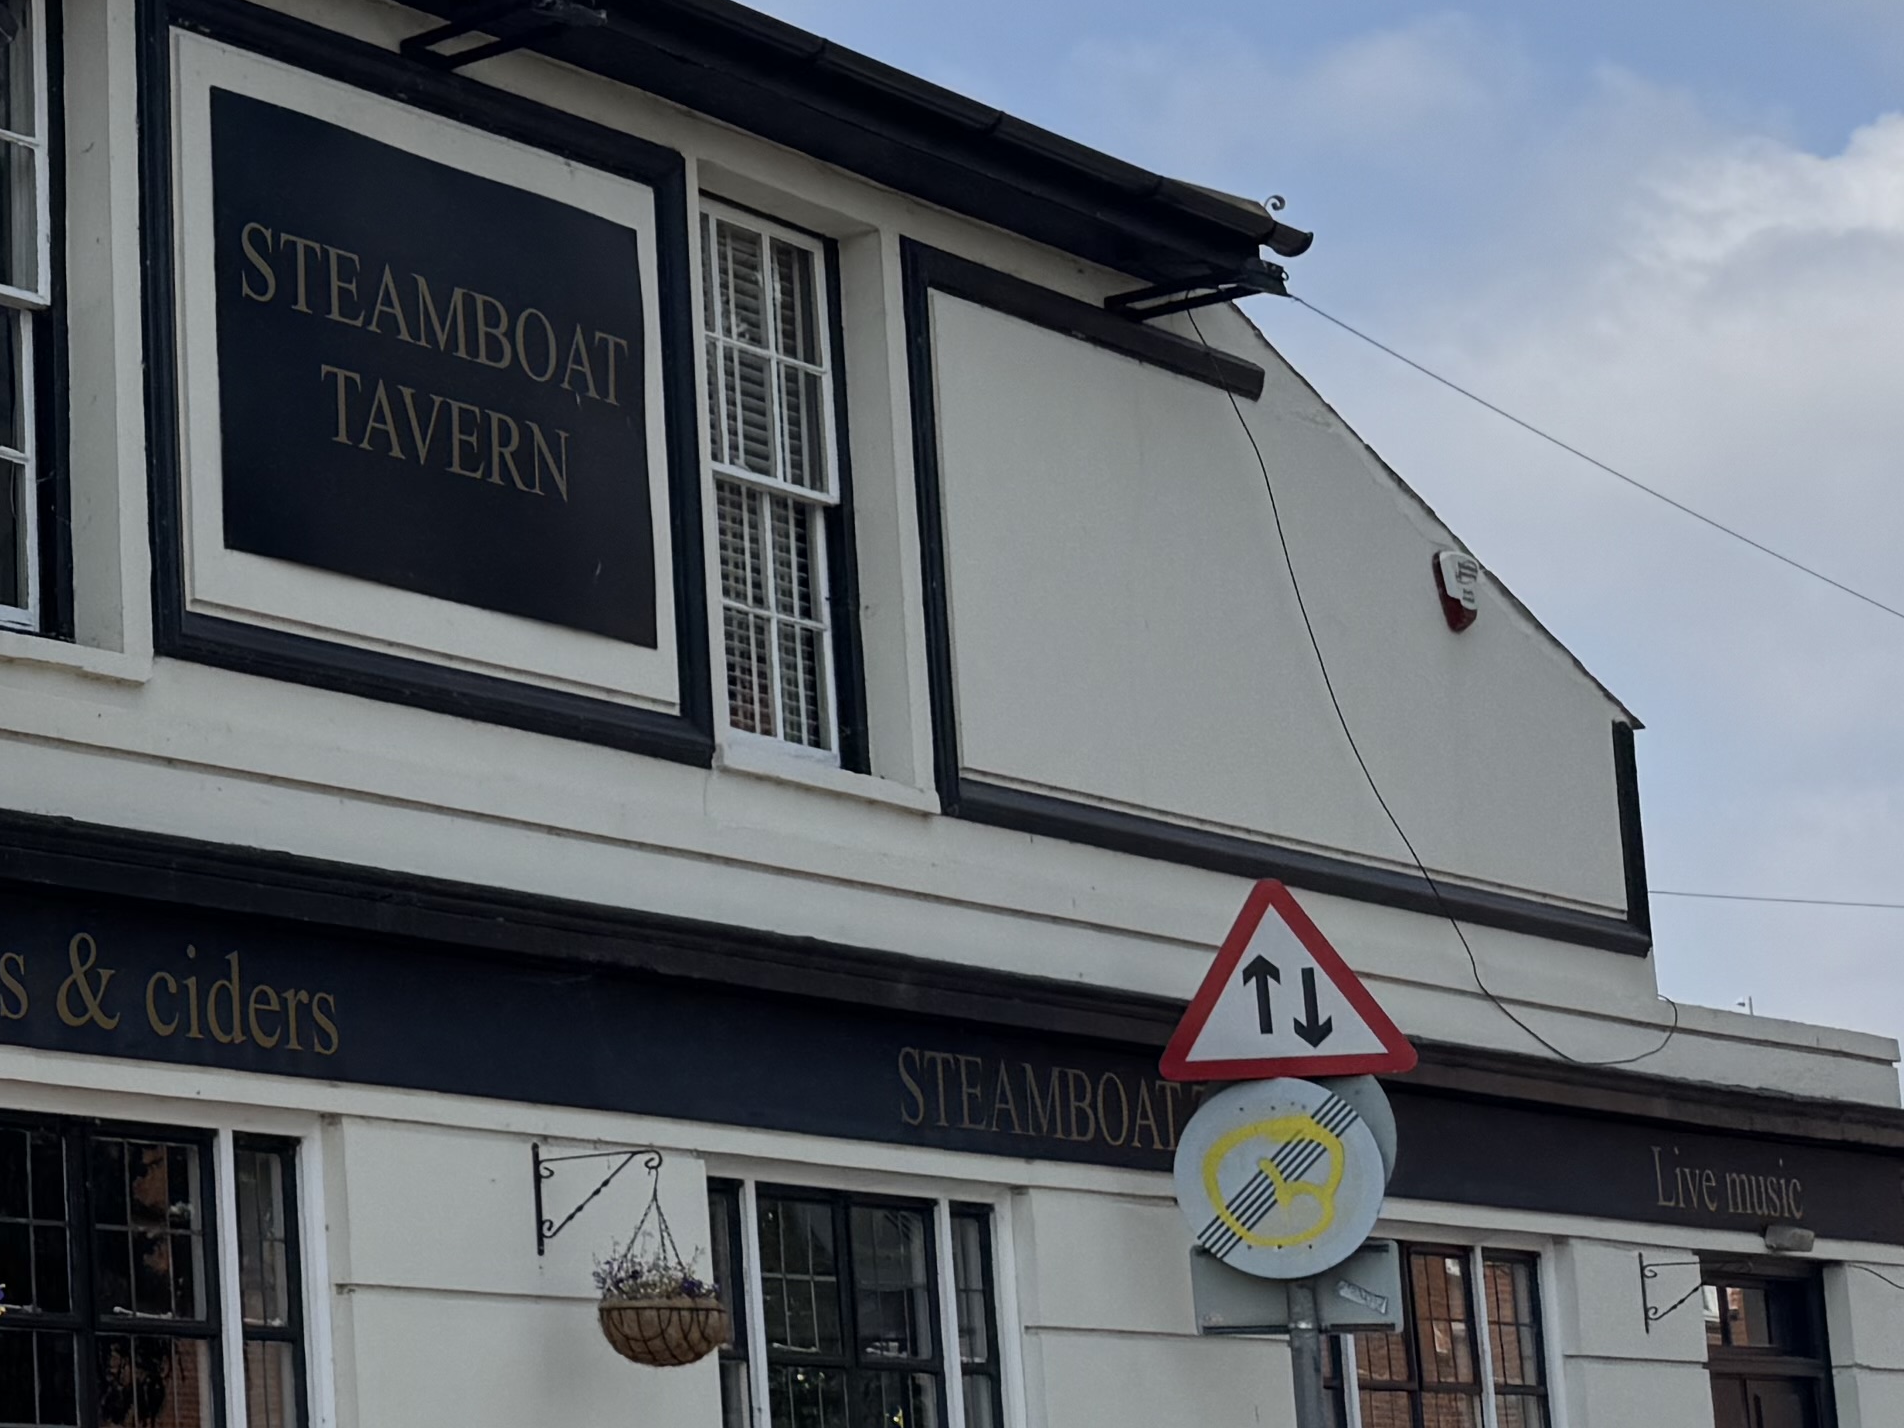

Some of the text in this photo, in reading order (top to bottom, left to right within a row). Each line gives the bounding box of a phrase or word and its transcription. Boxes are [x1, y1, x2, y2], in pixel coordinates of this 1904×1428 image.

[240, 221, 629, 406] STEAMBOAT
[320, 363, 570, 503] TAVERN
[55, 931, 120, 1030] &
[145, 943, 340, 1056] ciders
[897, 1045, 1182, 1152] STEAMBOAT
[1650, 1145, 1804, 1220] Live music
